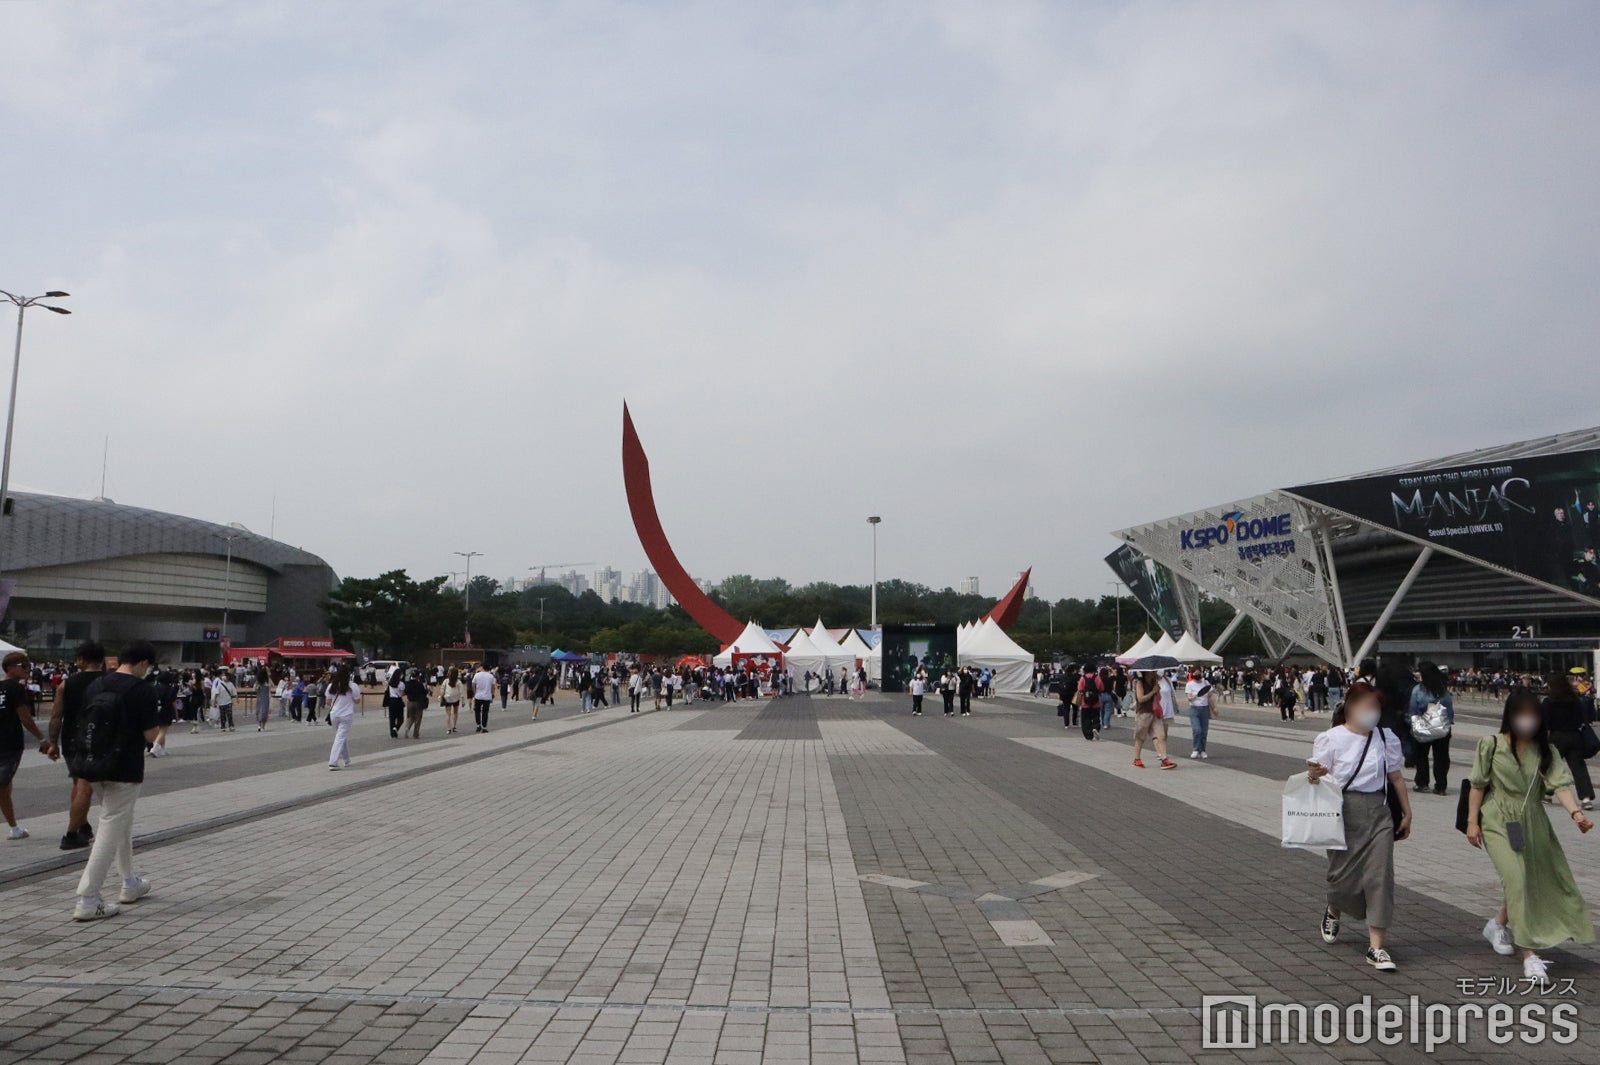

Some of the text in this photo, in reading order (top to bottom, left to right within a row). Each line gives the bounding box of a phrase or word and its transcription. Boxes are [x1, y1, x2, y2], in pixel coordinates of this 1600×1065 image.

[1180, 513, 1291, 550] KSPO DOME
[1428, 528, 1446, 538] Seoul
[1446, 525, 1470, 537] Special
[1512, 625, 1534, 639] 2-1
